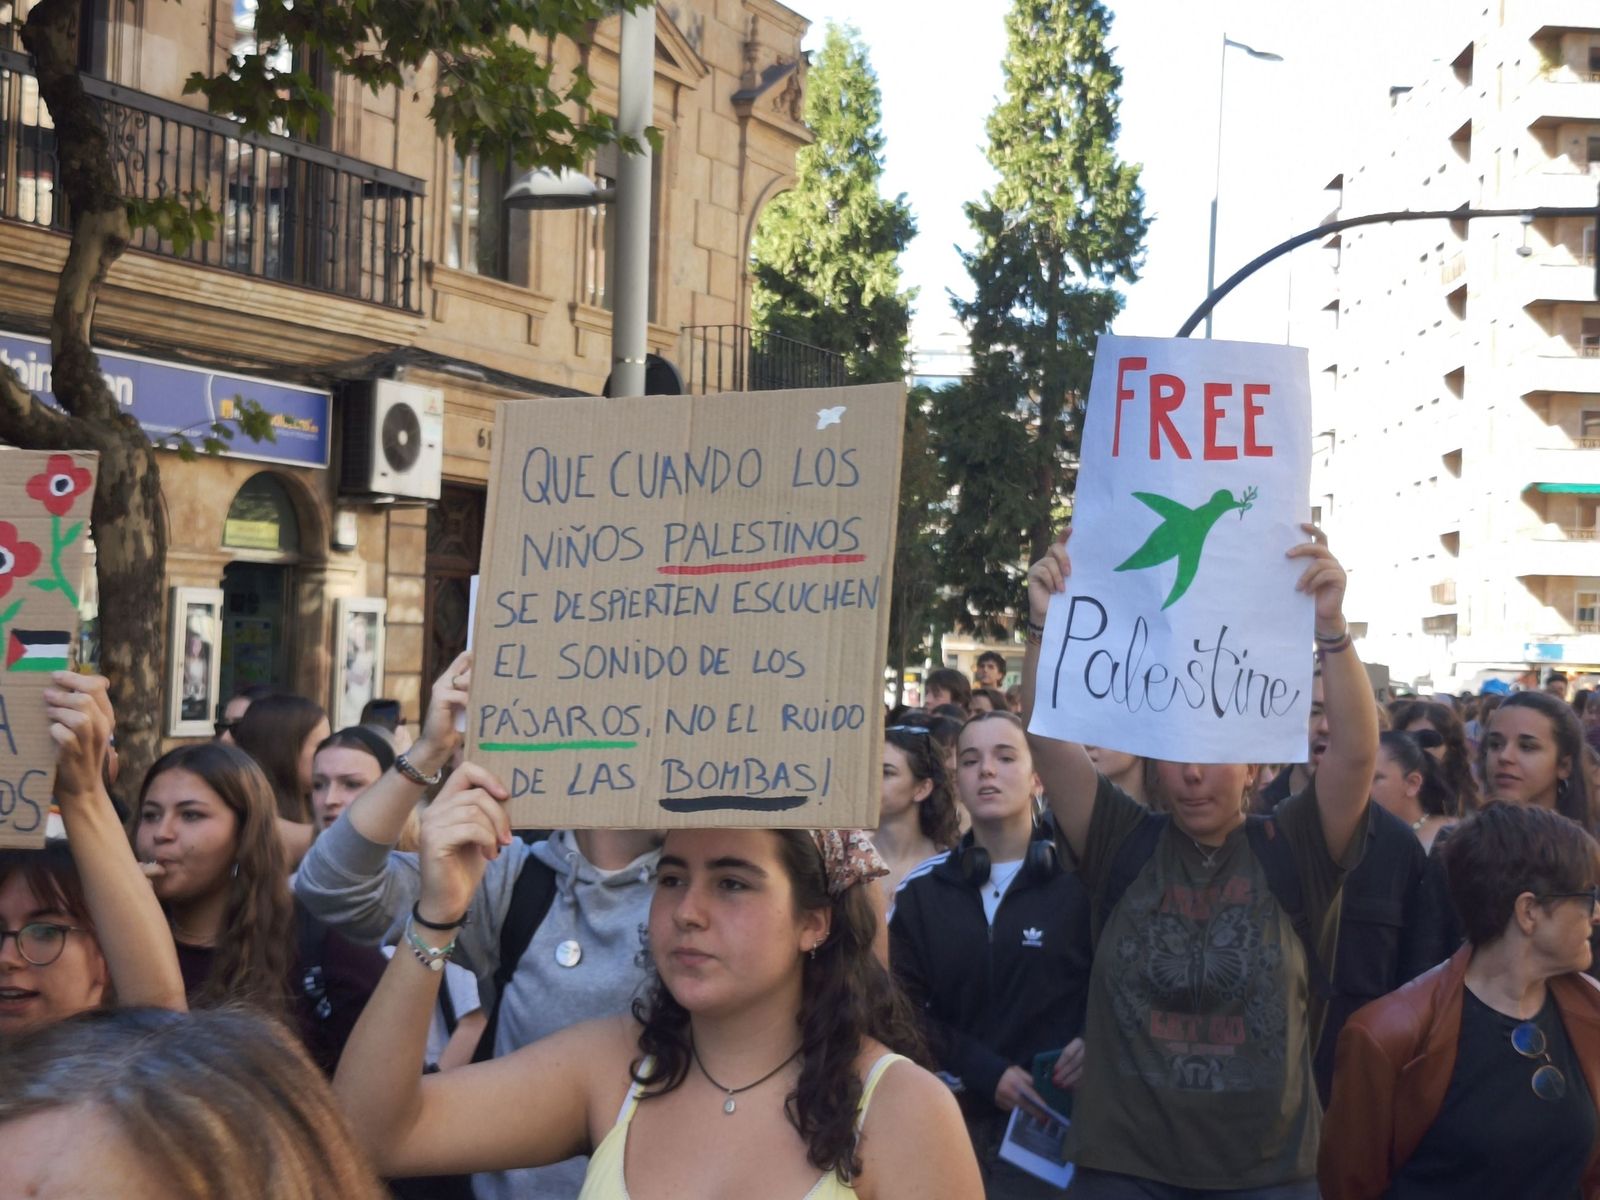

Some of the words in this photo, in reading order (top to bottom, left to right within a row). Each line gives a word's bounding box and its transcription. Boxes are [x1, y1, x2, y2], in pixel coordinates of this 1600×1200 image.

[1112, 357, 1273, 460] FREE
[522, 446, 595, 505] QUE
[610, 447, 763, 499] CUANDO
[793, 447, 860, 488] LOS
[494, 591, 538, 628] SE
[733, 576, 880, 614] ESCUCHEN
[493, 643, 537, 678] EL
[701, 647, 730, 676] DE
[753, 649, 806, 678] LOS
[1052, 596, 1299, 718] Palestine
[478, 699, 651, 738] PÁJAROS,
[666, 704, 715, 736] NO
[727, 704, 757, 733] EL
[511, 768, 545, 798] DE
[567, 763, 635, 796] LAS
